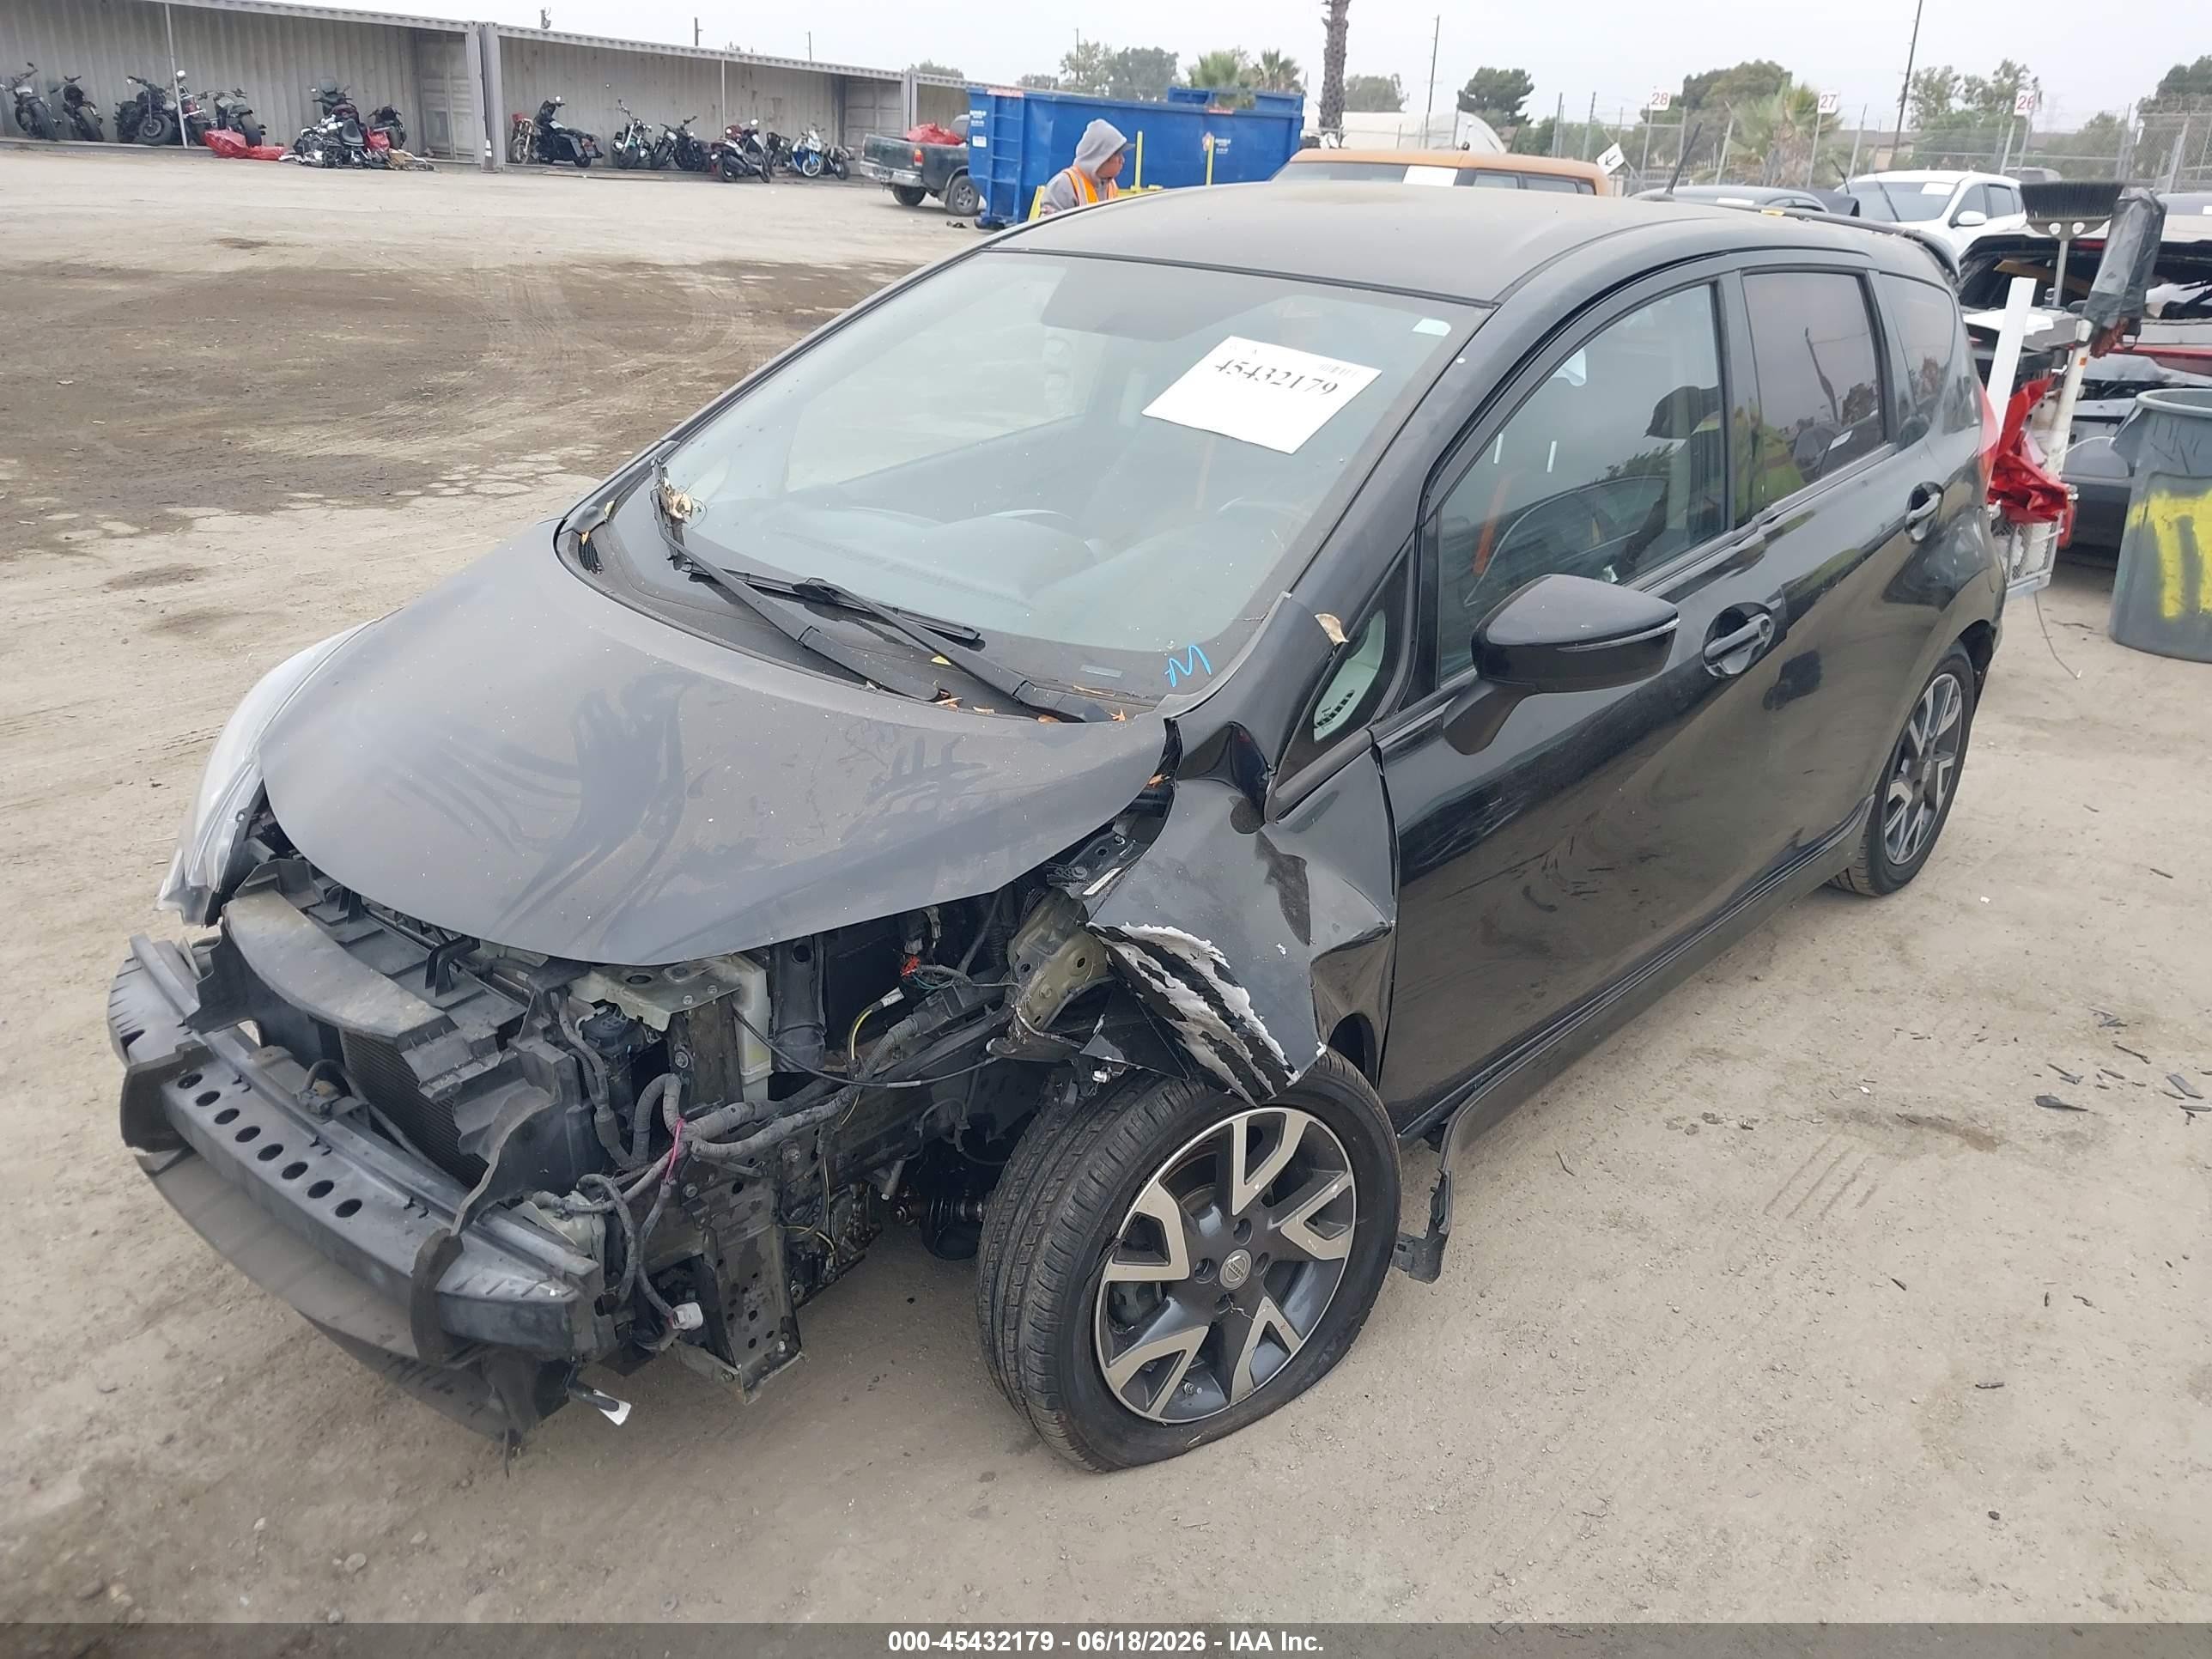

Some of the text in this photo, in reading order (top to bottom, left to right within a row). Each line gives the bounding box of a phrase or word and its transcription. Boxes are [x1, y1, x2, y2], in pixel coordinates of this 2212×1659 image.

[1650, 92, 1668, 105] 28
[1820, 94, 1838, 108] 27
[1215, 359, 1339, 396] 45432179
